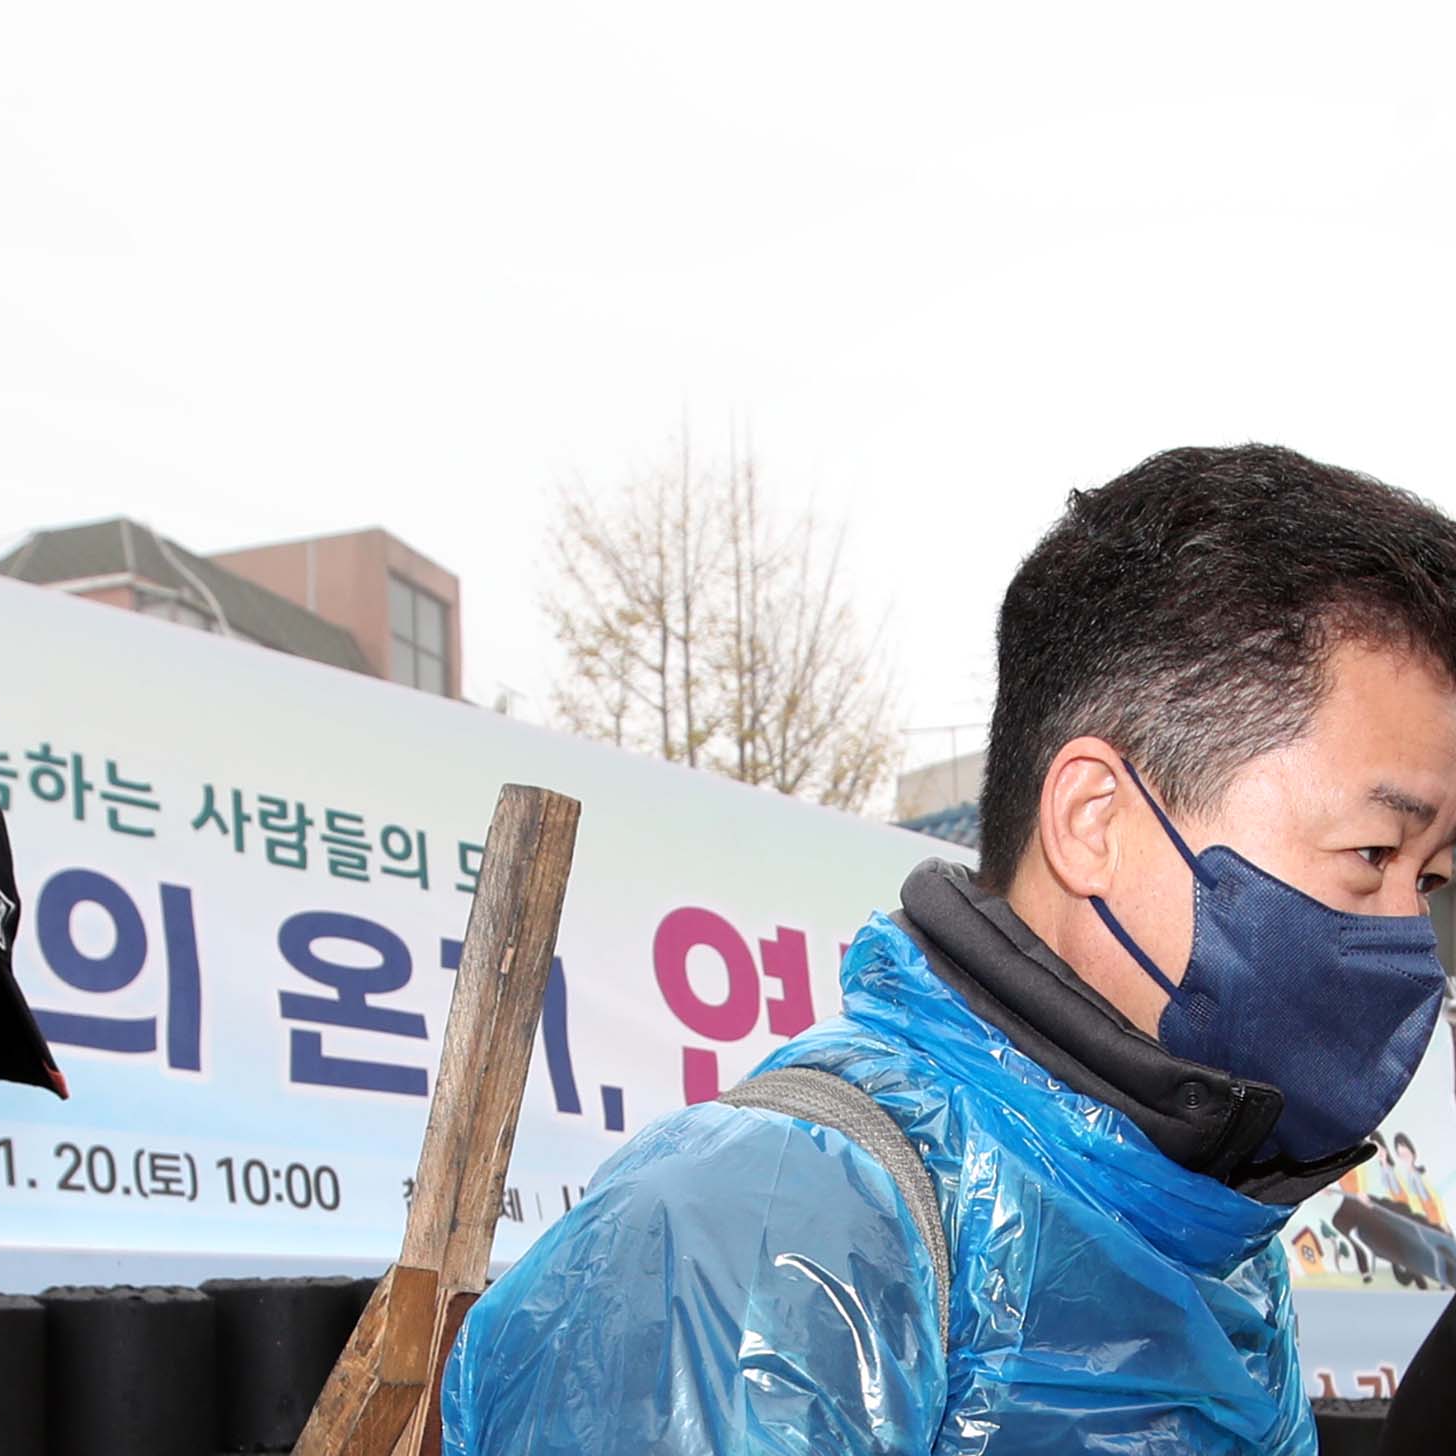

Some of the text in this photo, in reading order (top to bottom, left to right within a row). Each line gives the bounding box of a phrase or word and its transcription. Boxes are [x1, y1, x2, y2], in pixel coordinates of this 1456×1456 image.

[191, 783, 431, 891] 사람들의
[53, 1142, 199, 1201] 20.(토)
[215, 1156, 342, 1211] 10:00
